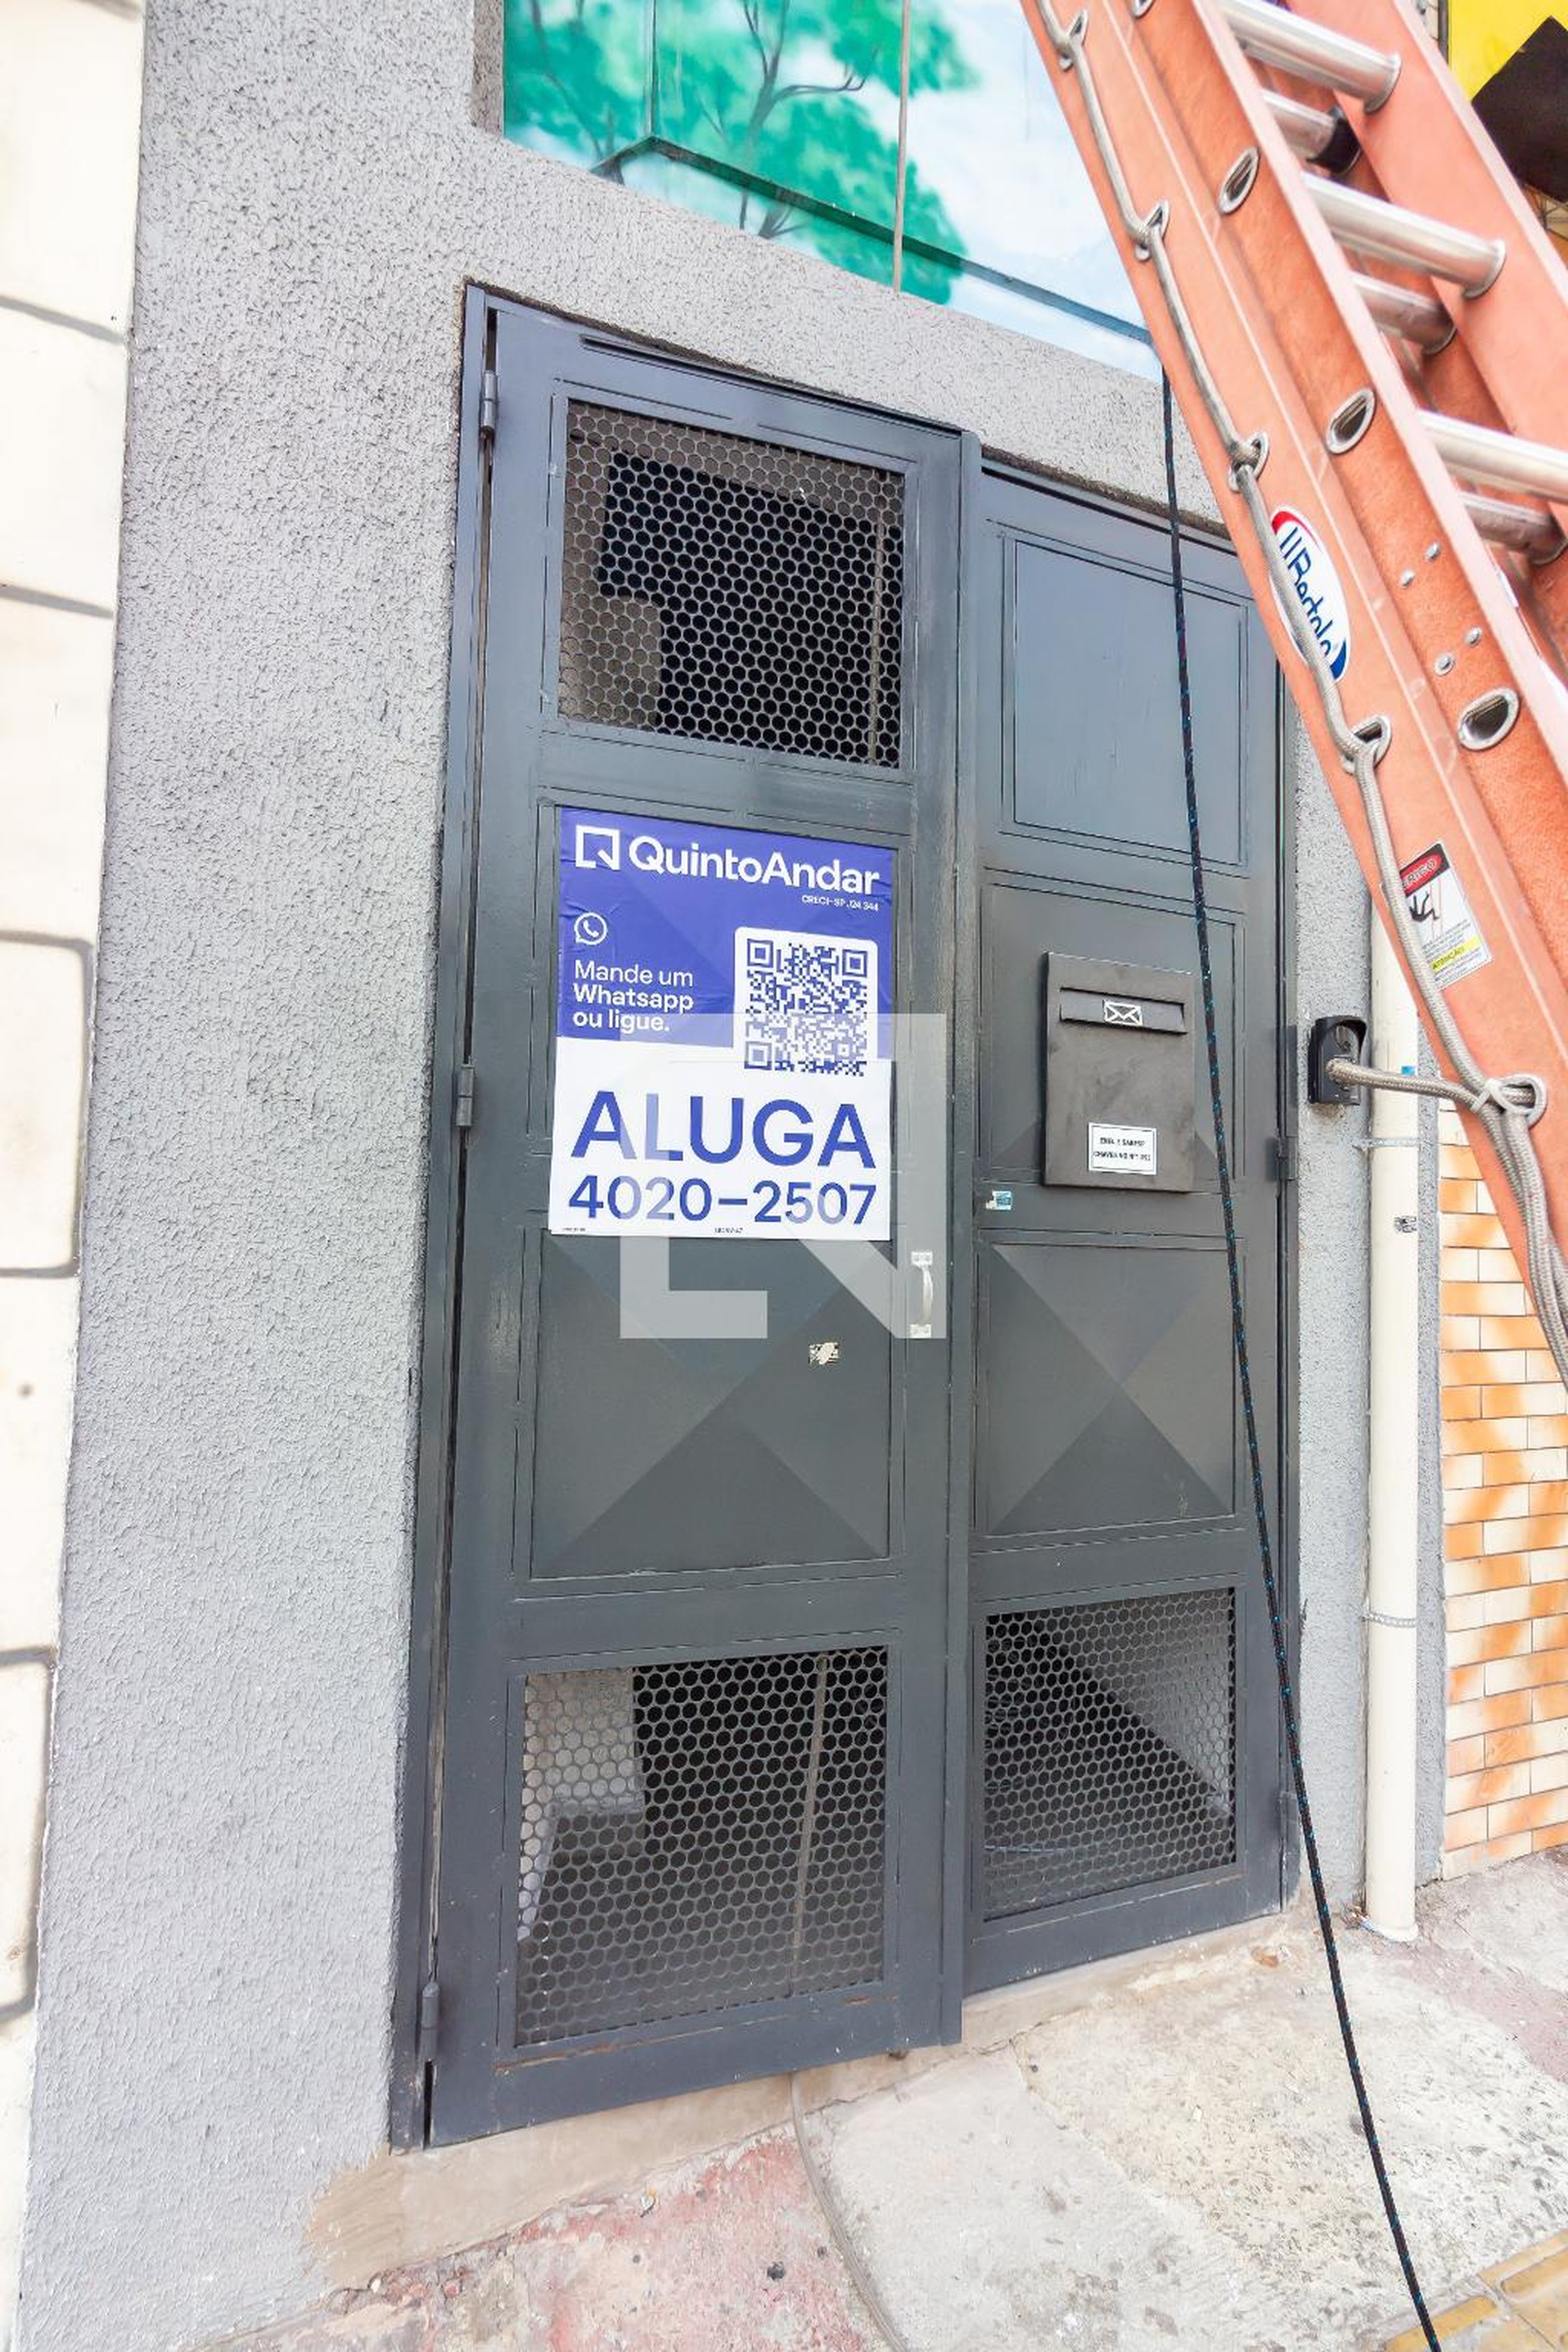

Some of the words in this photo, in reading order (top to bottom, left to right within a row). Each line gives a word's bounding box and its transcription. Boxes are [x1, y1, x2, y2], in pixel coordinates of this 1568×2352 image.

[628, 835, 880, 895] QuintoAndar
[575, 960, 653, 984] Mande
[659, 969, 693, 987] um
[573, 984, 693, 1013] Whatsapp
[573, 1012, 602, 1028] ou
[609, 1011, 670, 1033] ligue.
[571, 1091, 876, 1169] ALUGA
[569, 1175, 876, 1224] 4020-2507
